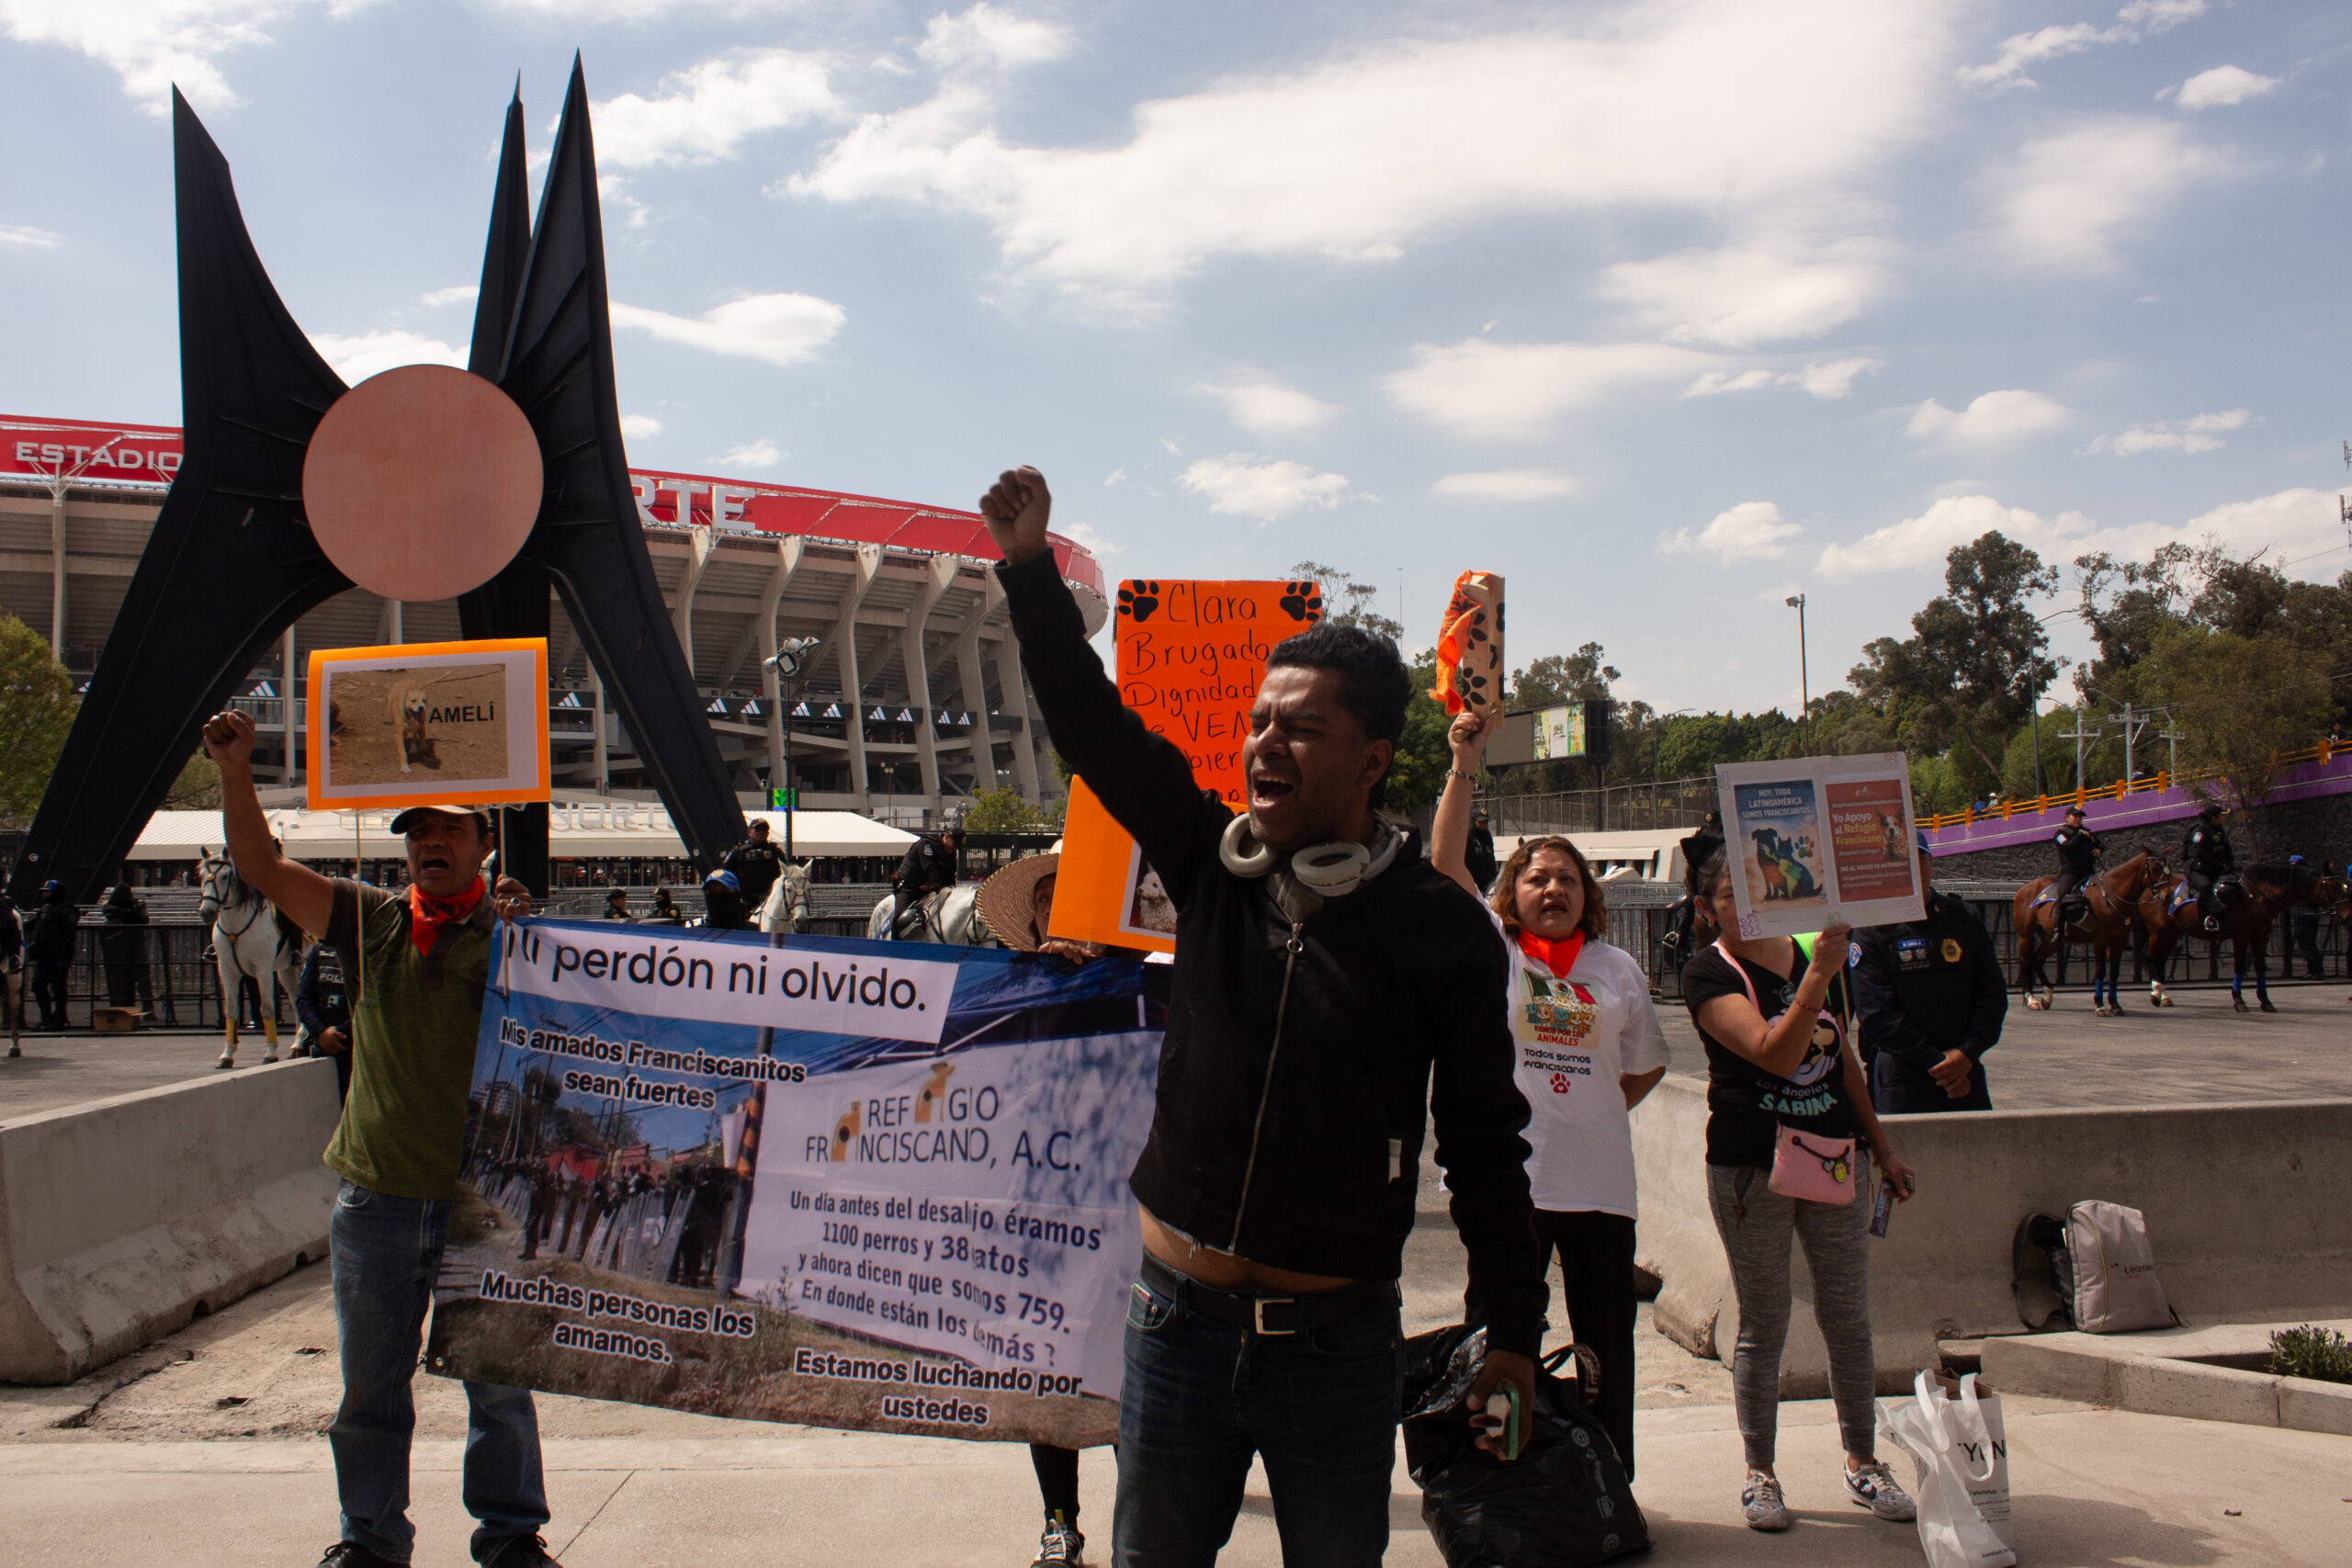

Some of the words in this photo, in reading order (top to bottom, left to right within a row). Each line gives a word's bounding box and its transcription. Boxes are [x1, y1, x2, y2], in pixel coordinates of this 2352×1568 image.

[16, 441, 183, 470] ESTADIO
[630, 475, 755, 530] RTE
[1169, 581, 1257, 627] Clara
[1125, 628, 1270, 677] Brugada
[1123, 667, 1258, 716] Dignidad
[428, 701, 494, 724] AMELÍ
[549, 802, 676, 827] NORT
[1742, 810, 1763, 819] SOMOS
[1832, 814, 1843, 823] Yo
[1845, 812, 1871, 824] Apoyo
[1835, 826, 1842, 835] al
[1844, 822, 1877, 834] Refugio
[1836, 835, 1882, 845] Franciscano
[552, 944, 714, 990] perdón
[729, 954, 769, 996] ni
[782, 961, 926, 1011] olvido.
[501, 1018, 526, 1046] Mis
[529, 1030, 624, 1062] amados
[628, 1042, 806, 1082] Franciscanitos
[1536, 1032, 1579, 1046] ANIMALES
[1557, 1028, 1571, 1036] POR
[1572, 1030, 1585, 1039] LOS
[1523, 1060, 1591, 1076] Franciscanos
[1524, 1048, 1555, 1060] Todos
[1556, 1053, 1591, 1064] somos
[564, 1071, 621, 1097] sean
[626, 1076, 716, 1108] fuertes
[1758, 1091, 1838, 1117] SABINA
[1782, 1083, 1829, 1100] ángeles
[1012, 1130, 1080, 1171] A.C.
[791, 1190, 809, 1210] Un
[815, 1192, 835, 1213] día
[840, 1195, 880, 1217] antes
[885, 1197, 911, 1219] del
[1004, 1208, 1102, 1251] éramos
[822, 1222, 858, 1247] 1100
[864, 1231, 919, 1255] perros
[923, 1239, 933, 1262] y
[480, 1270, 585, 1308] Muchas
[587, 1291, 710, 1331] personas
[713, 1305, 755, 1337] los
[797, 1253, 807, 1271] y
[811, 1251, 852, 1277] ahora
[857, 1259, 902, 1287] dicen
[908, 1271, 943, 1296] que
[1017, 1292, 1070, 1334] 759.
[802, 1279, 822, 1302] En
[827, 1285, 875, 1314] donde
[880, 1300, 929, 1330] están
[937, 1308, 967, 1337] los
[973, 1318, 1035, 1363] demás
[554, 1323, 673, 1363] amamos.
[794, 1348, 909, 1382] Estamos
[912, 1359, 1034, 1392] luchando
[1036, 1371, 1083, 1397] por
[883, 1395, 989, 1425] ustedes
